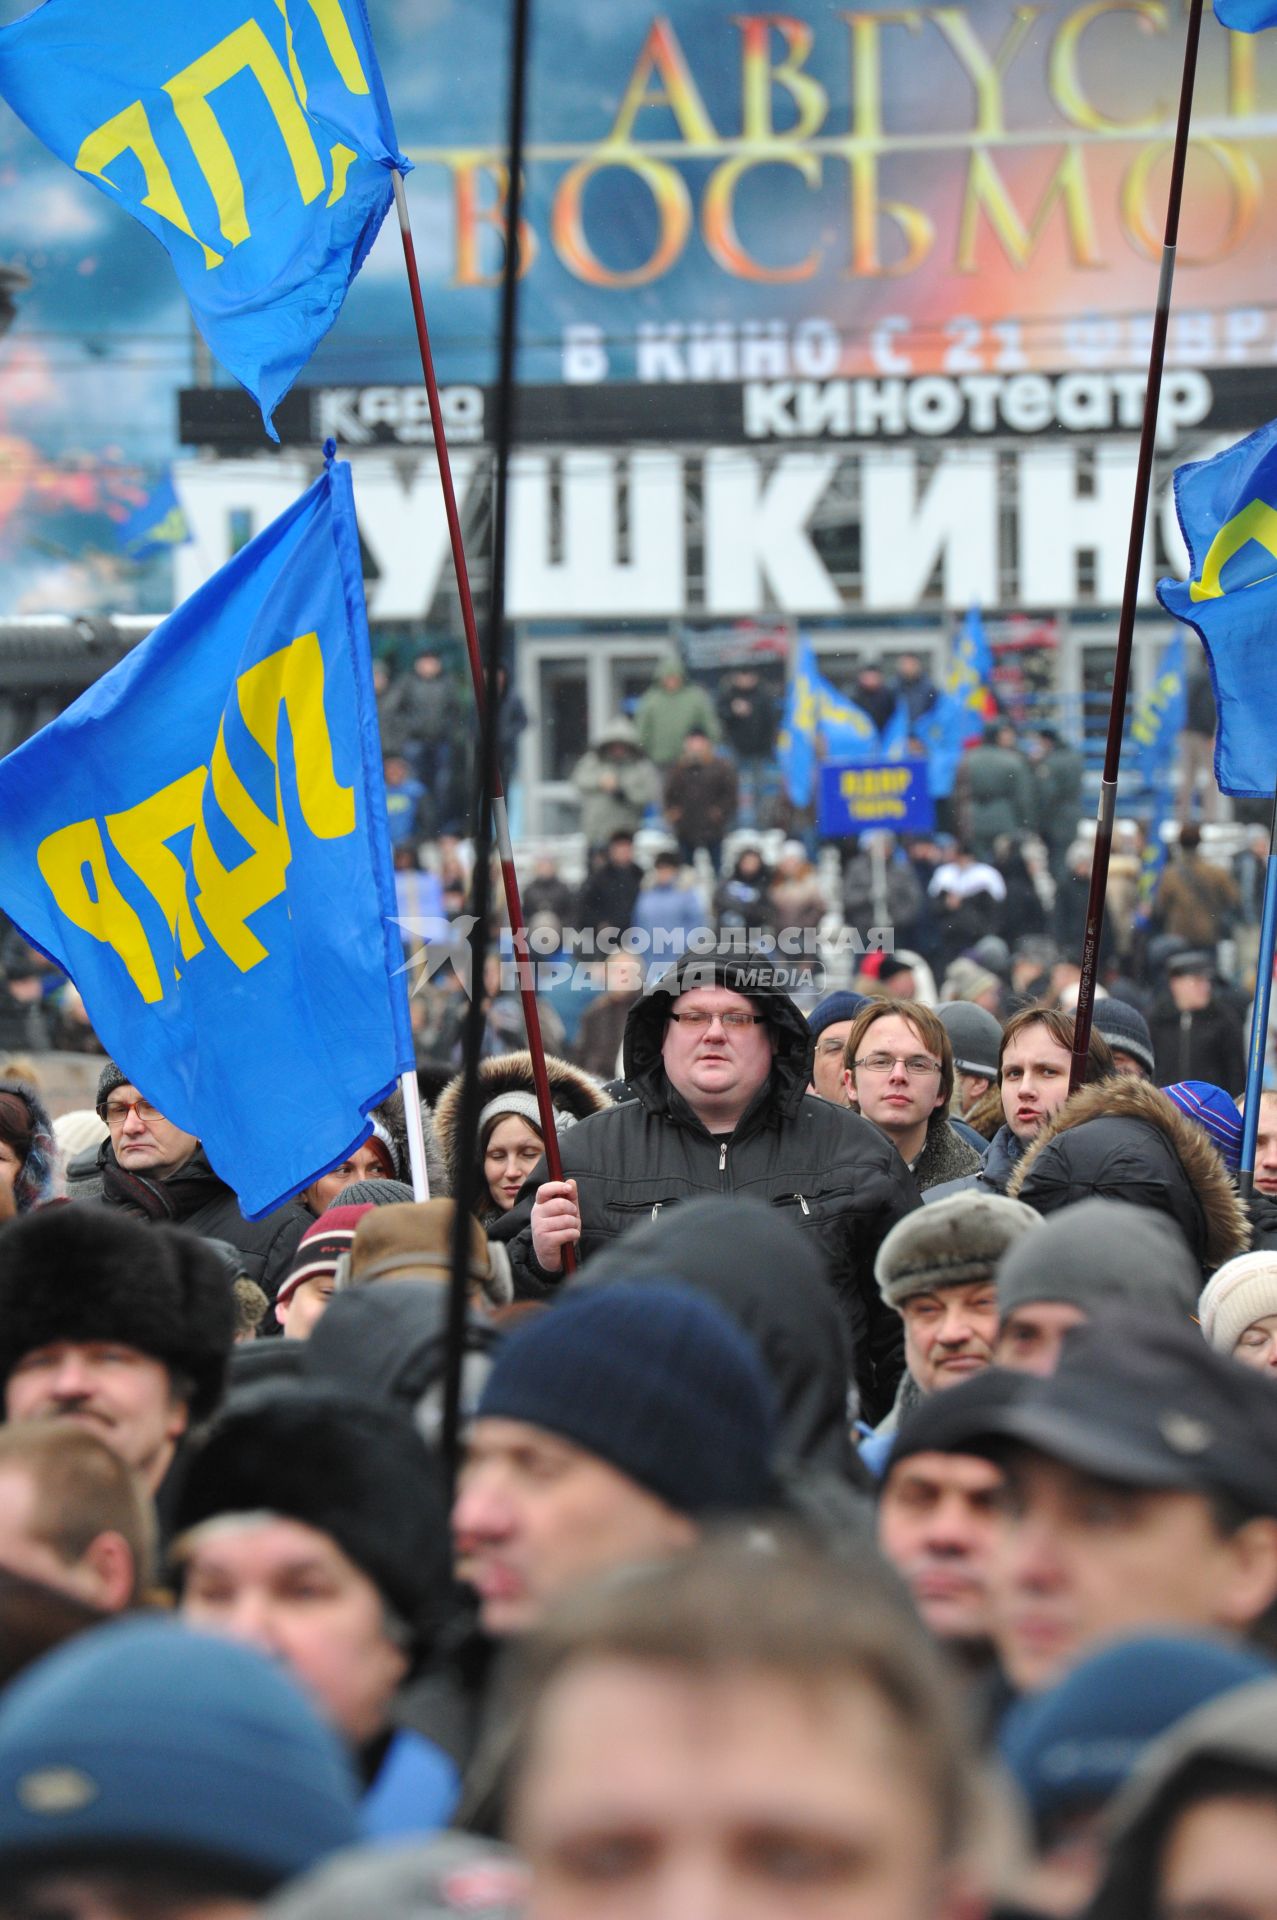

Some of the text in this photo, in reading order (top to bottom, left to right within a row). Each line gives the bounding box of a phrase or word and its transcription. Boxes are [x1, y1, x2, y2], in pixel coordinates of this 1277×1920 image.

[562, 307, 1277, 384] В КИНО С 21 ФЕВР
[1083, 940, 1095, 974] FISHING
